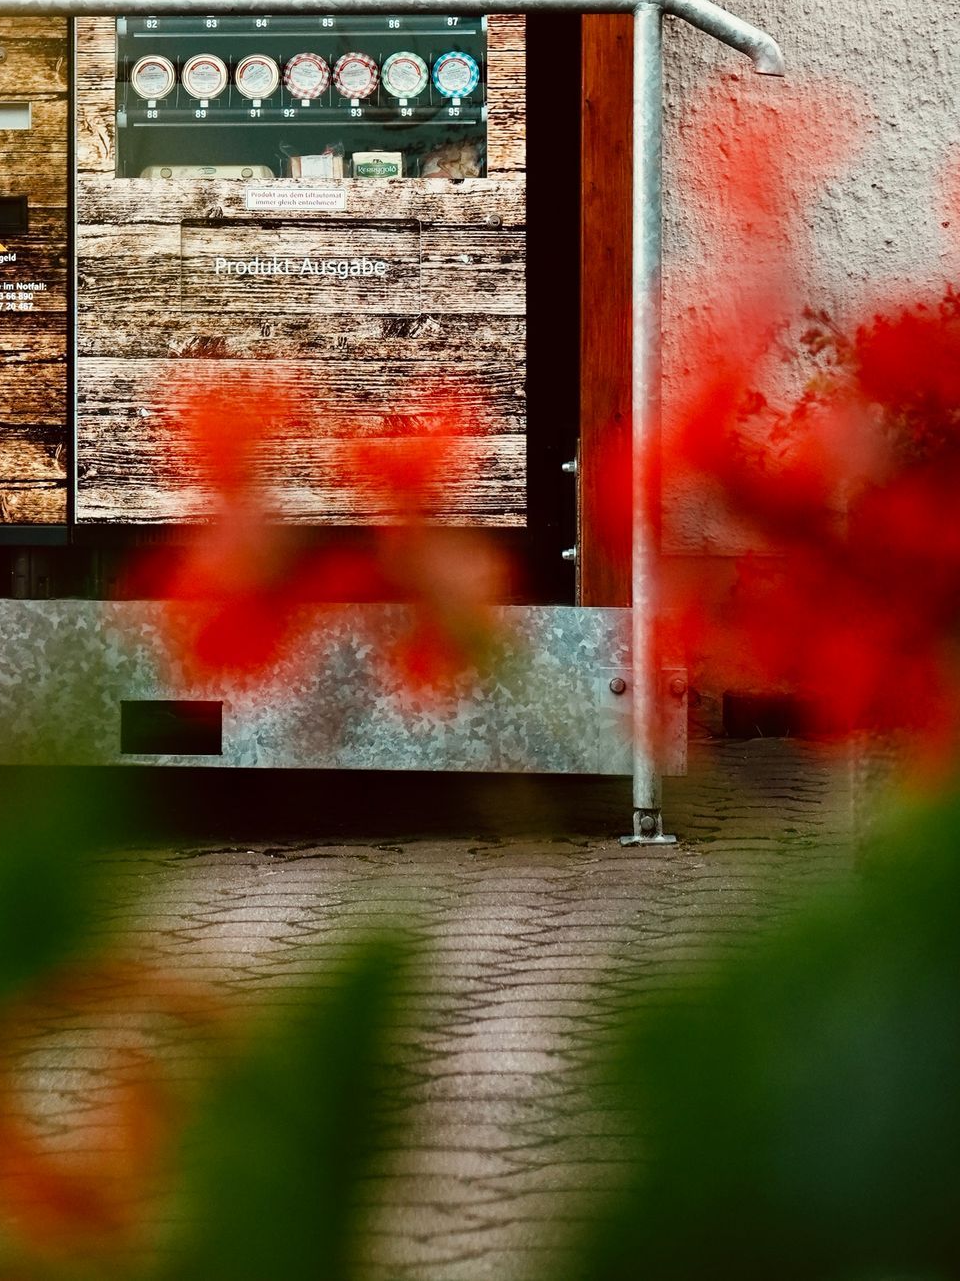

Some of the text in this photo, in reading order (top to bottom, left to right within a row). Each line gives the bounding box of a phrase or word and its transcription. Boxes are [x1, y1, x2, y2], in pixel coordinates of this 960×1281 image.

[146, 18, 458, 28] 82 83 84 85 86 87
[147, 108, 459, 118] 88 89 91 92 93 94 95
[214, 257, 386, 280] Produkt-Ausgabe
[16, 283, 47, 291] Notfall:
[6, 292, 16, 300] 66
[18, 292, 34, 300] 890
